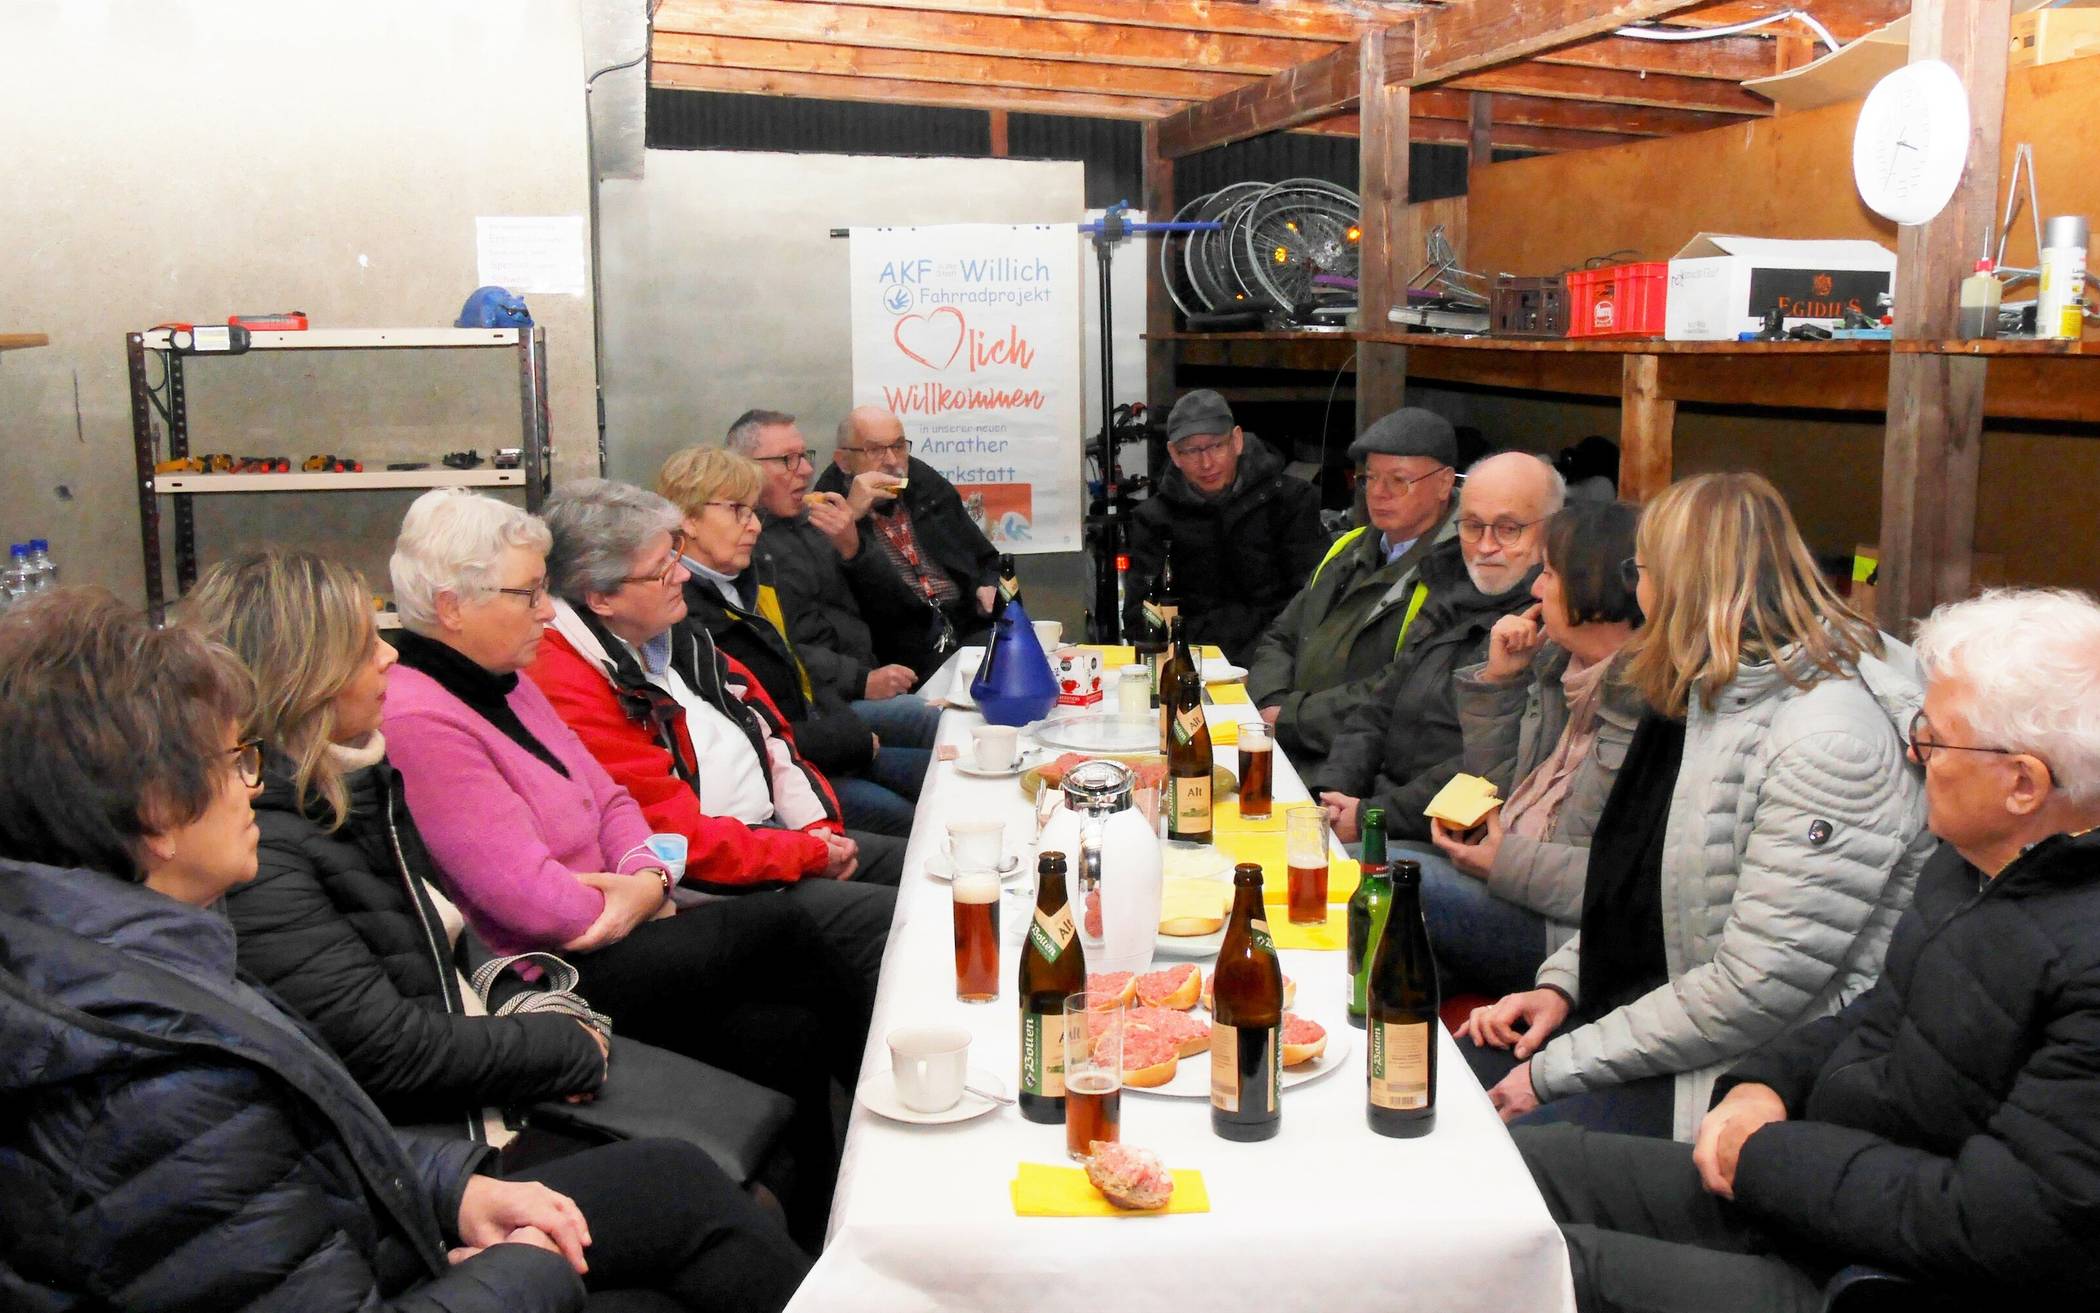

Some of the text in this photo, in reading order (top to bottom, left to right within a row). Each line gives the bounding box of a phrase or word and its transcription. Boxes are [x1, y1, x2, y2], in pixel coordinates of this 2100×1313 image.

[879, 260, 933, 283] AKF
[960, 258, 1049, 282] Willich
[920, 287, 1051, 306] Fahrradprojekt
[969, 325, 1035, 372] lich
[882, 382, 1045, 415] Willkommen
[920, 424, 928, 434] in
[921, 435, 1008, 453] Anrather
[937, 465, 1015, 482] erkstatt
[1187, 786, 1202, 797] Alt
[1059, 918, 1074, 940] Alt
[1024, 1017, 1034, 1073] Bolten
